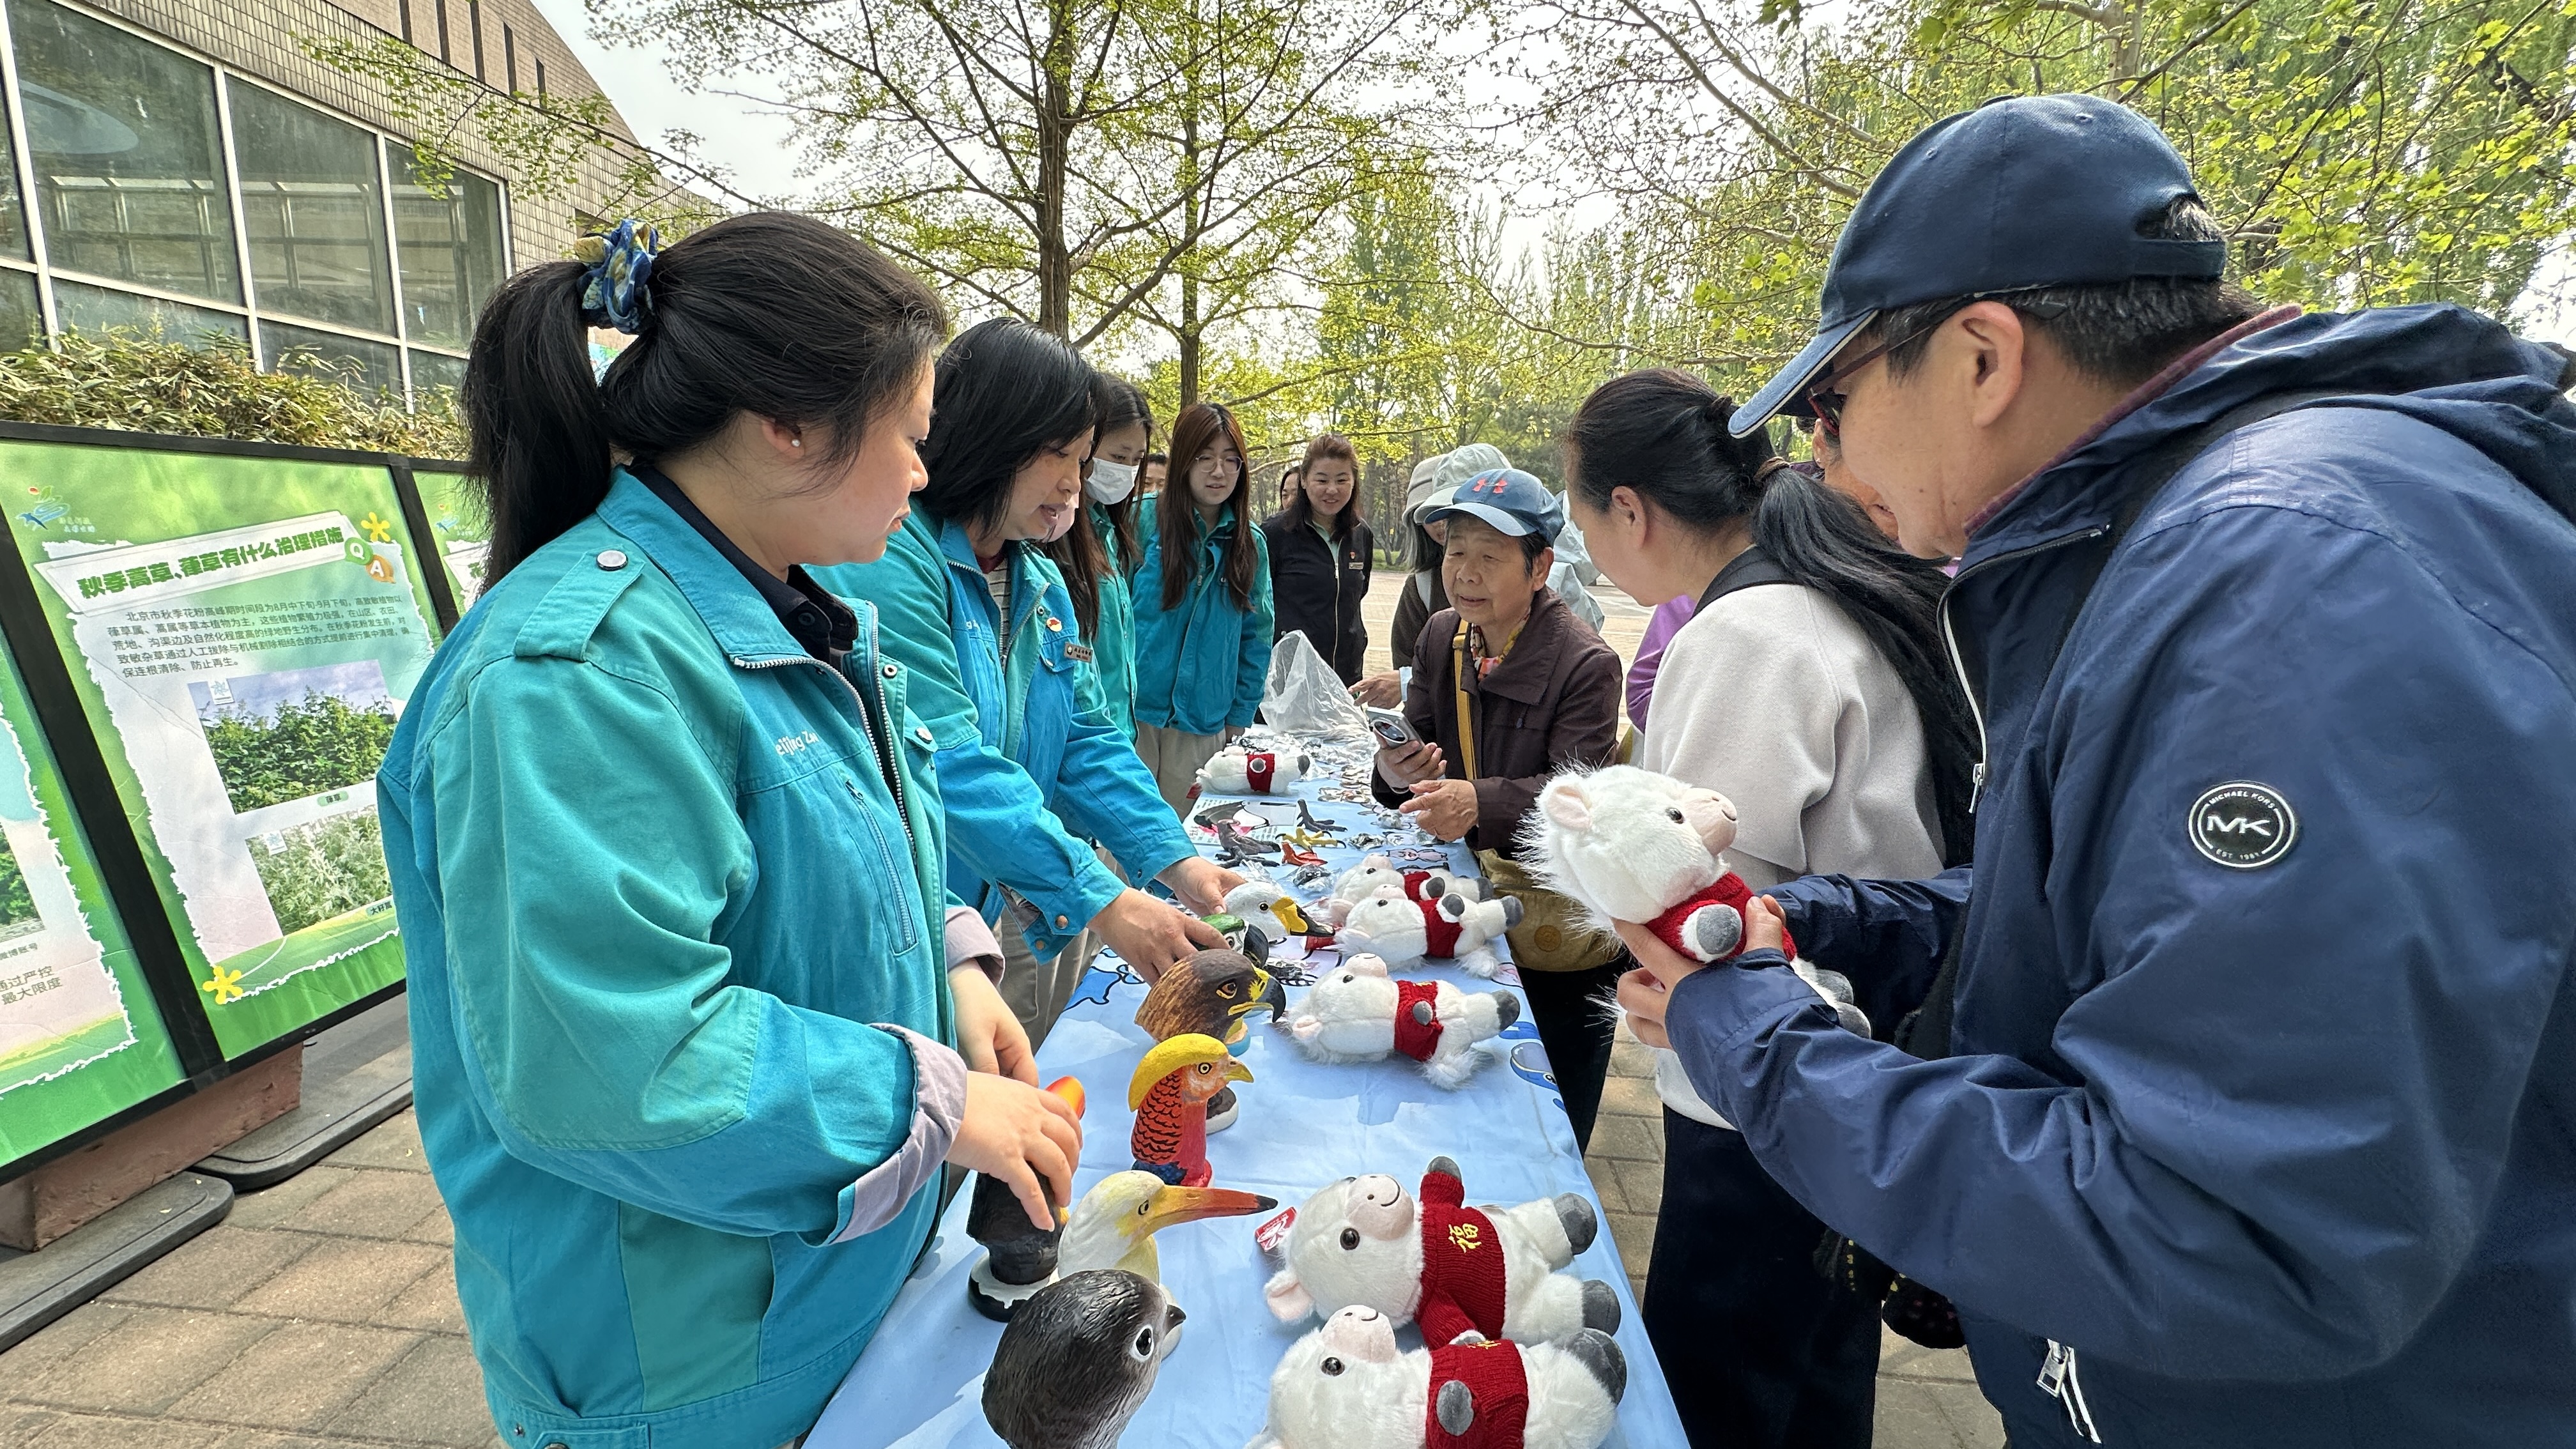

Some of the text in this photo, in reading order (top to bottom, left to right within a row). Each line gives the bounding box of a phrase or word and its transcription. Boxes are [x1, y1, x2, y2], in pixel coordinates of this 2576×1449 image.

[76, 526, 344, 599] 秋季蒿草、葎草有什么治理措施
[349, 542, 385, 578] Q A
[122, 657, 238, 678] 保连根清除、防止再生。
[2209, 790, 2276, 809] MICHAEL KORS
[2207, 815, 2272, 836] MK
[1, 977, 63, 1005] 最大限度
[1448, 1223, 1482, 1254] 福
